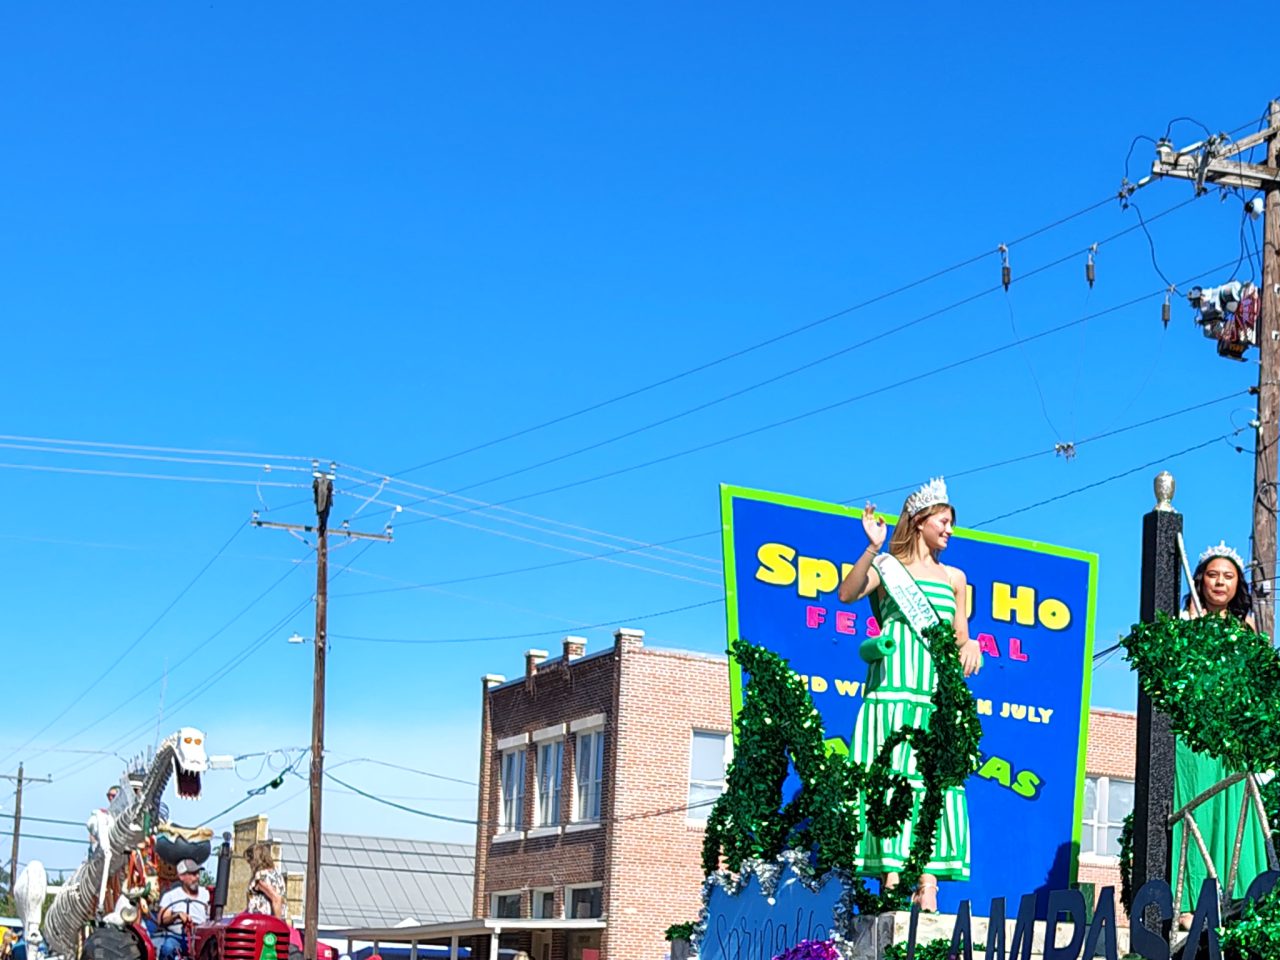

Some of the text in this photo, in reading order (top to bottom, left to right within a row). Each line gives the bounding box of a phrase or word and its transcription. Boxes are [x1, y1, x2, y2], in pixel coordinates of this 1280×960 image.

[993, 582, 1070, 630] Ho
[806, 605, 1028, 662] FESAL
[1000, 702, 1054, 724] JULY
